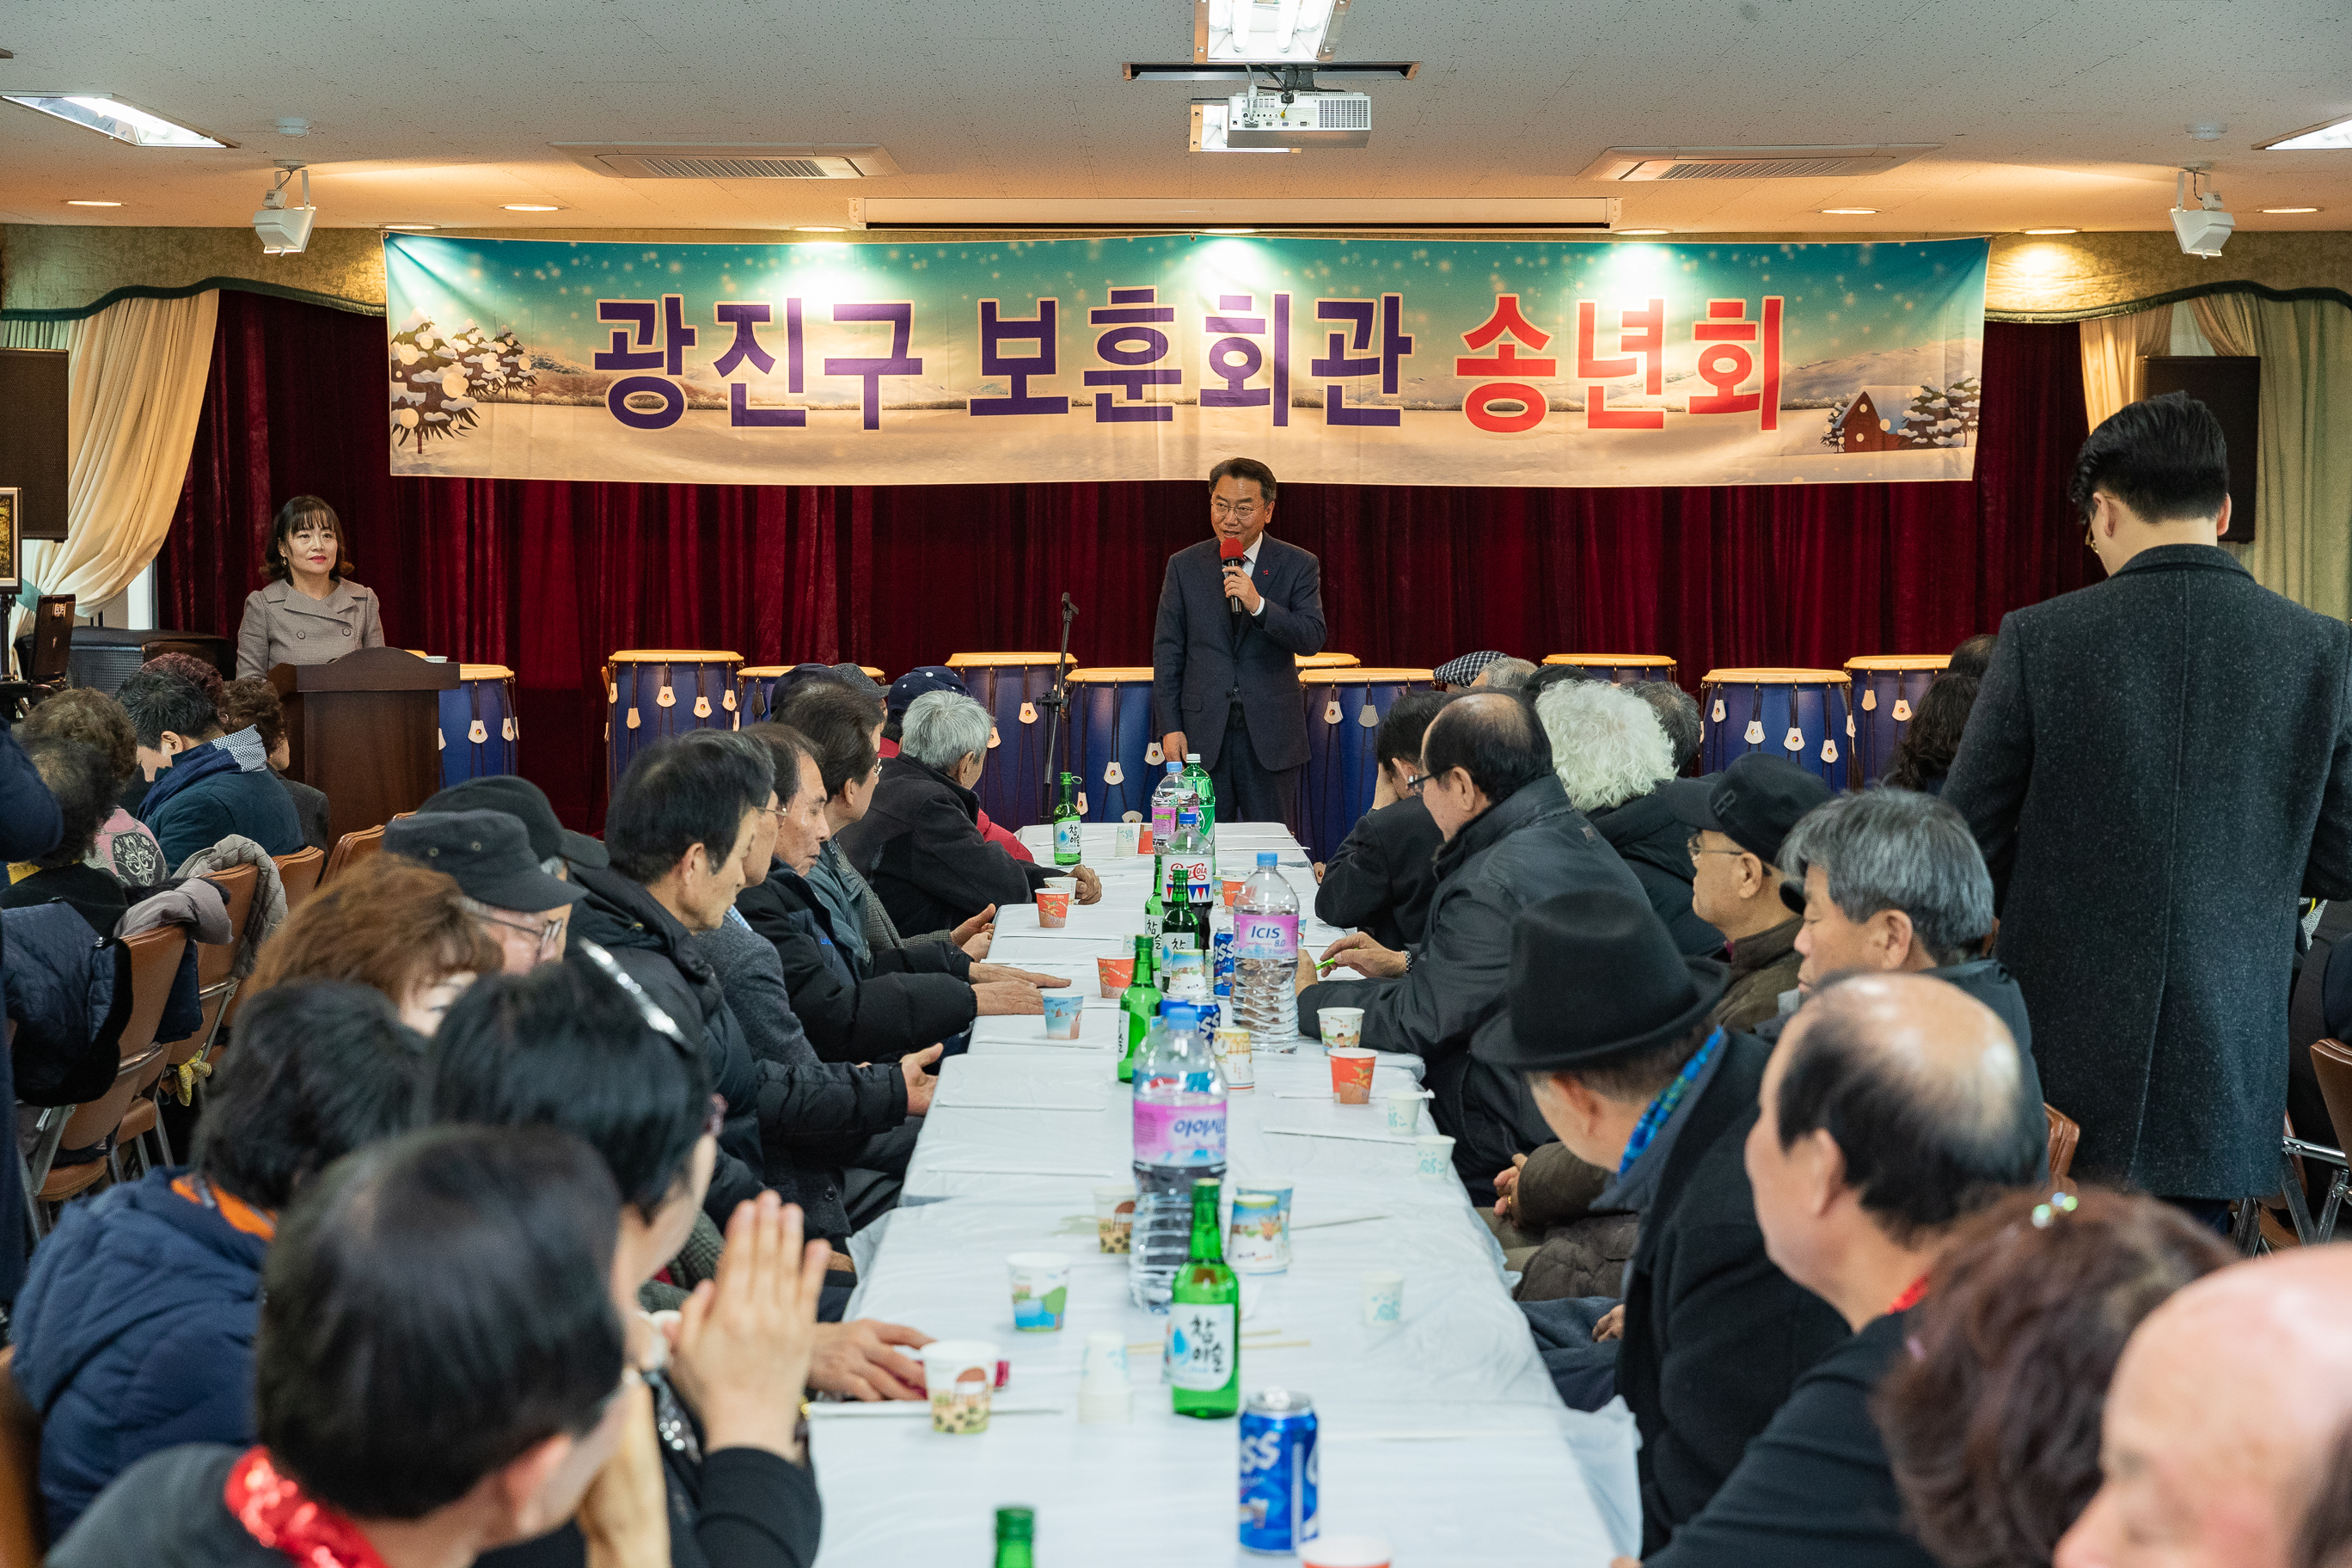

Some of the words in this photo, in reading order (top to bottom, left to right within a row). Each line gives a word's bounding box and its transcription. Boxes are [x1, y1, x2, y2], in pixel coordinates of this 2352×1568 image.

[594, 294, 922, 430] 광진구
[970, 287, 1412, 427] 보훈회관
[1456, 296, 1782, 432] 송년회
[1146, 919, 1158, 935] 참
[1251, 925, 1280, 939] ICIS
[1154, 934, 1162, 950] 슬
